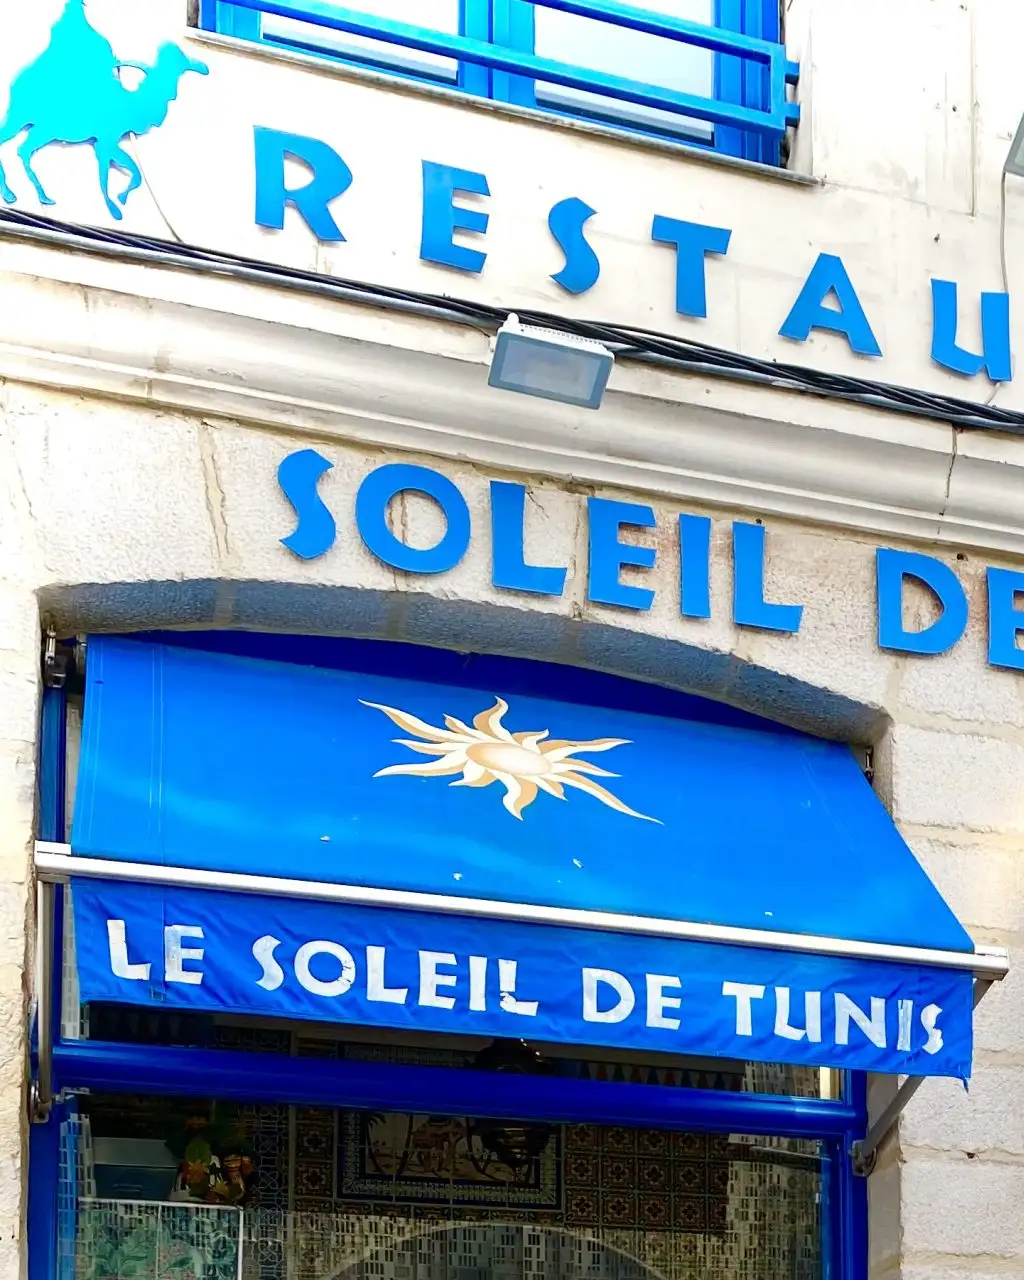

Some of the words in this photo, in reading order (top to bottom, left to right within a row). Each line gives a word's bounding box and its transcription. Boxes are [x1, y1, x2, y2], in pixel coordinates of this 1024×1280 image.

[277, 448, 804, 634] SOLEIL
[106, 919, 203, 985] LE
[254, 934, 539, 1016] SOLEIL
[581, 966, 688, 1031] DE
[721, 980, 943, 1056] TUNIS
